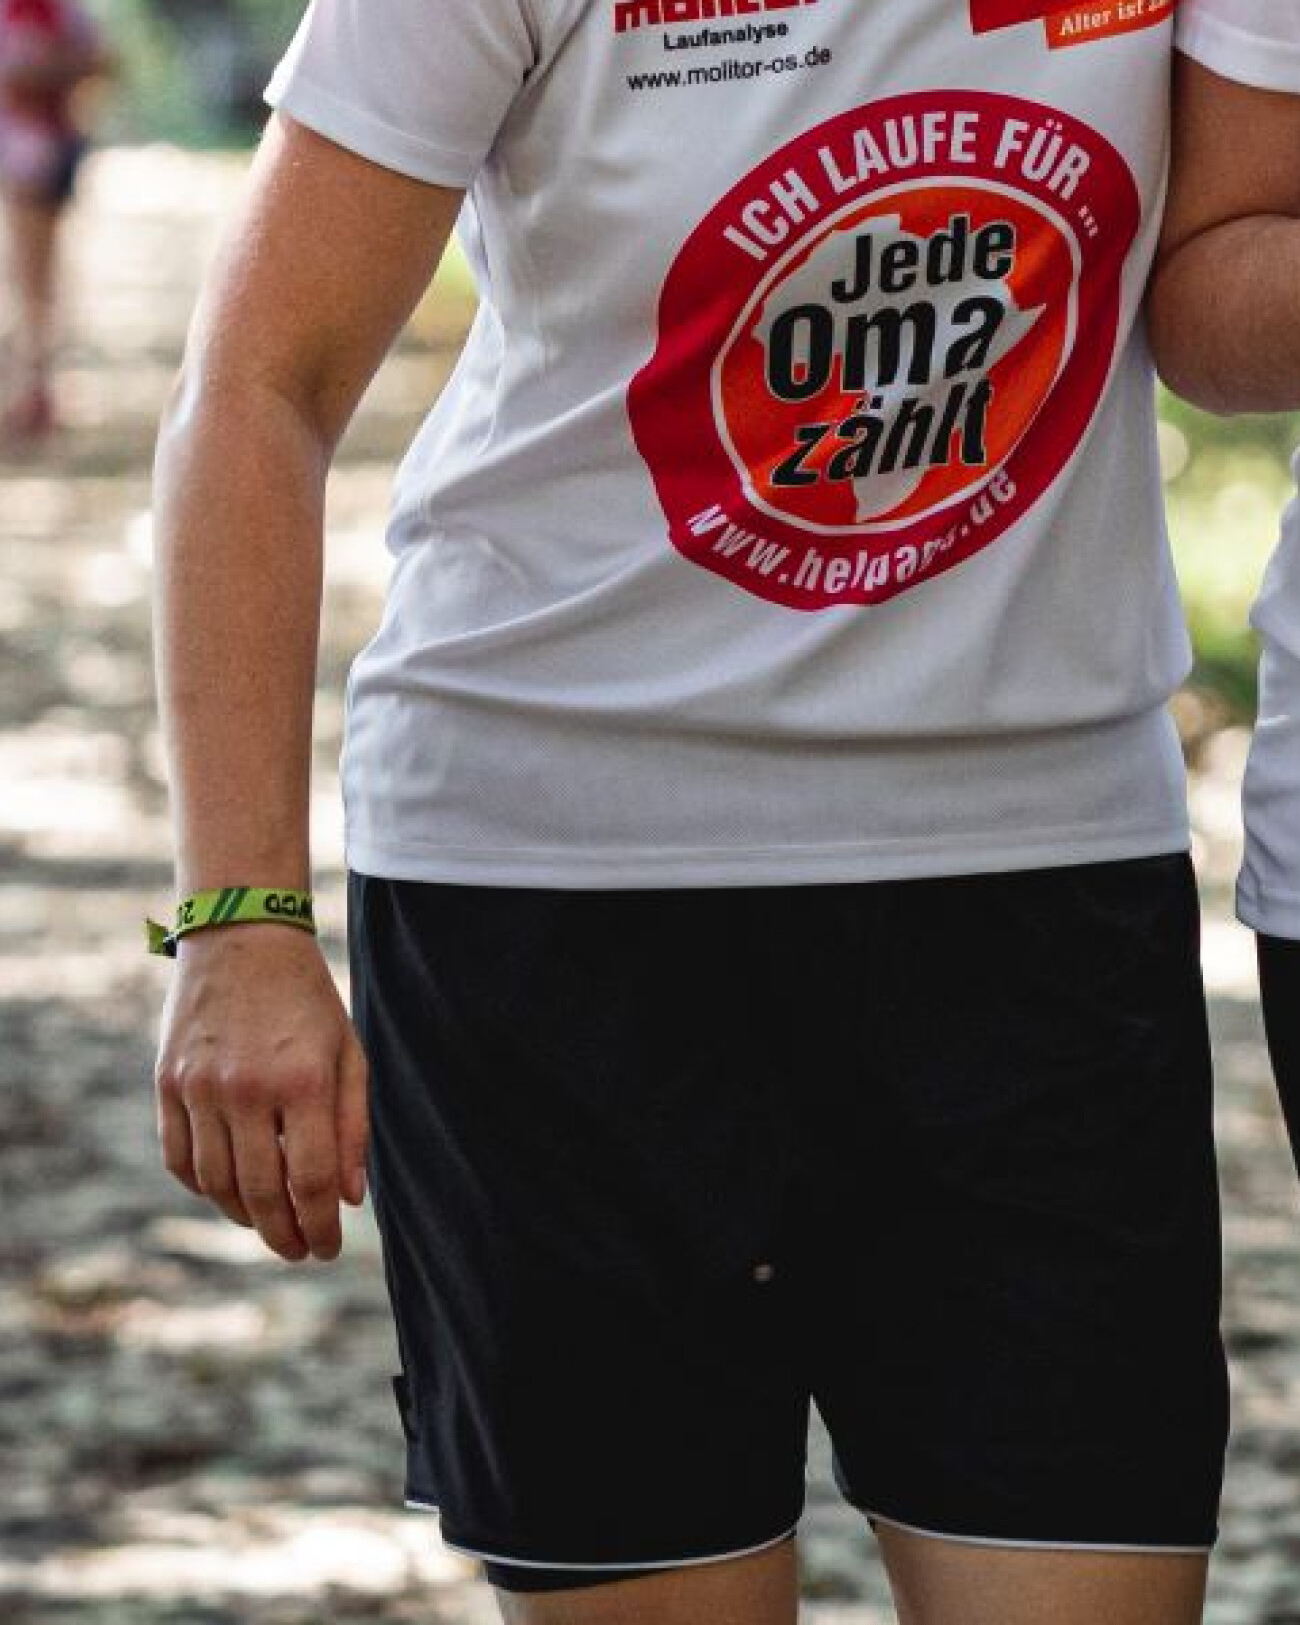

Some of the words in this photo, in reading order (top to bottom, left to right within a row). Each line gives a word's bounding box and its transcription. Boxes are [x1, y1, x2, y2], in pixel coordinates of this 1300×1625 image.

[663, 21, 790, 51] Laufanalyse
[1059, 9, 1112, 36] Alter
[627, 45, 833, 91] www.molitor-os.de
[723, 168, 820, 261] ICH
[817, 111, 980, 195] LAUFE
[831, 214, 1015, 304] Jede
[768, 295, 1006, 401] Oma
[771, 377, 993, 487] zählt
